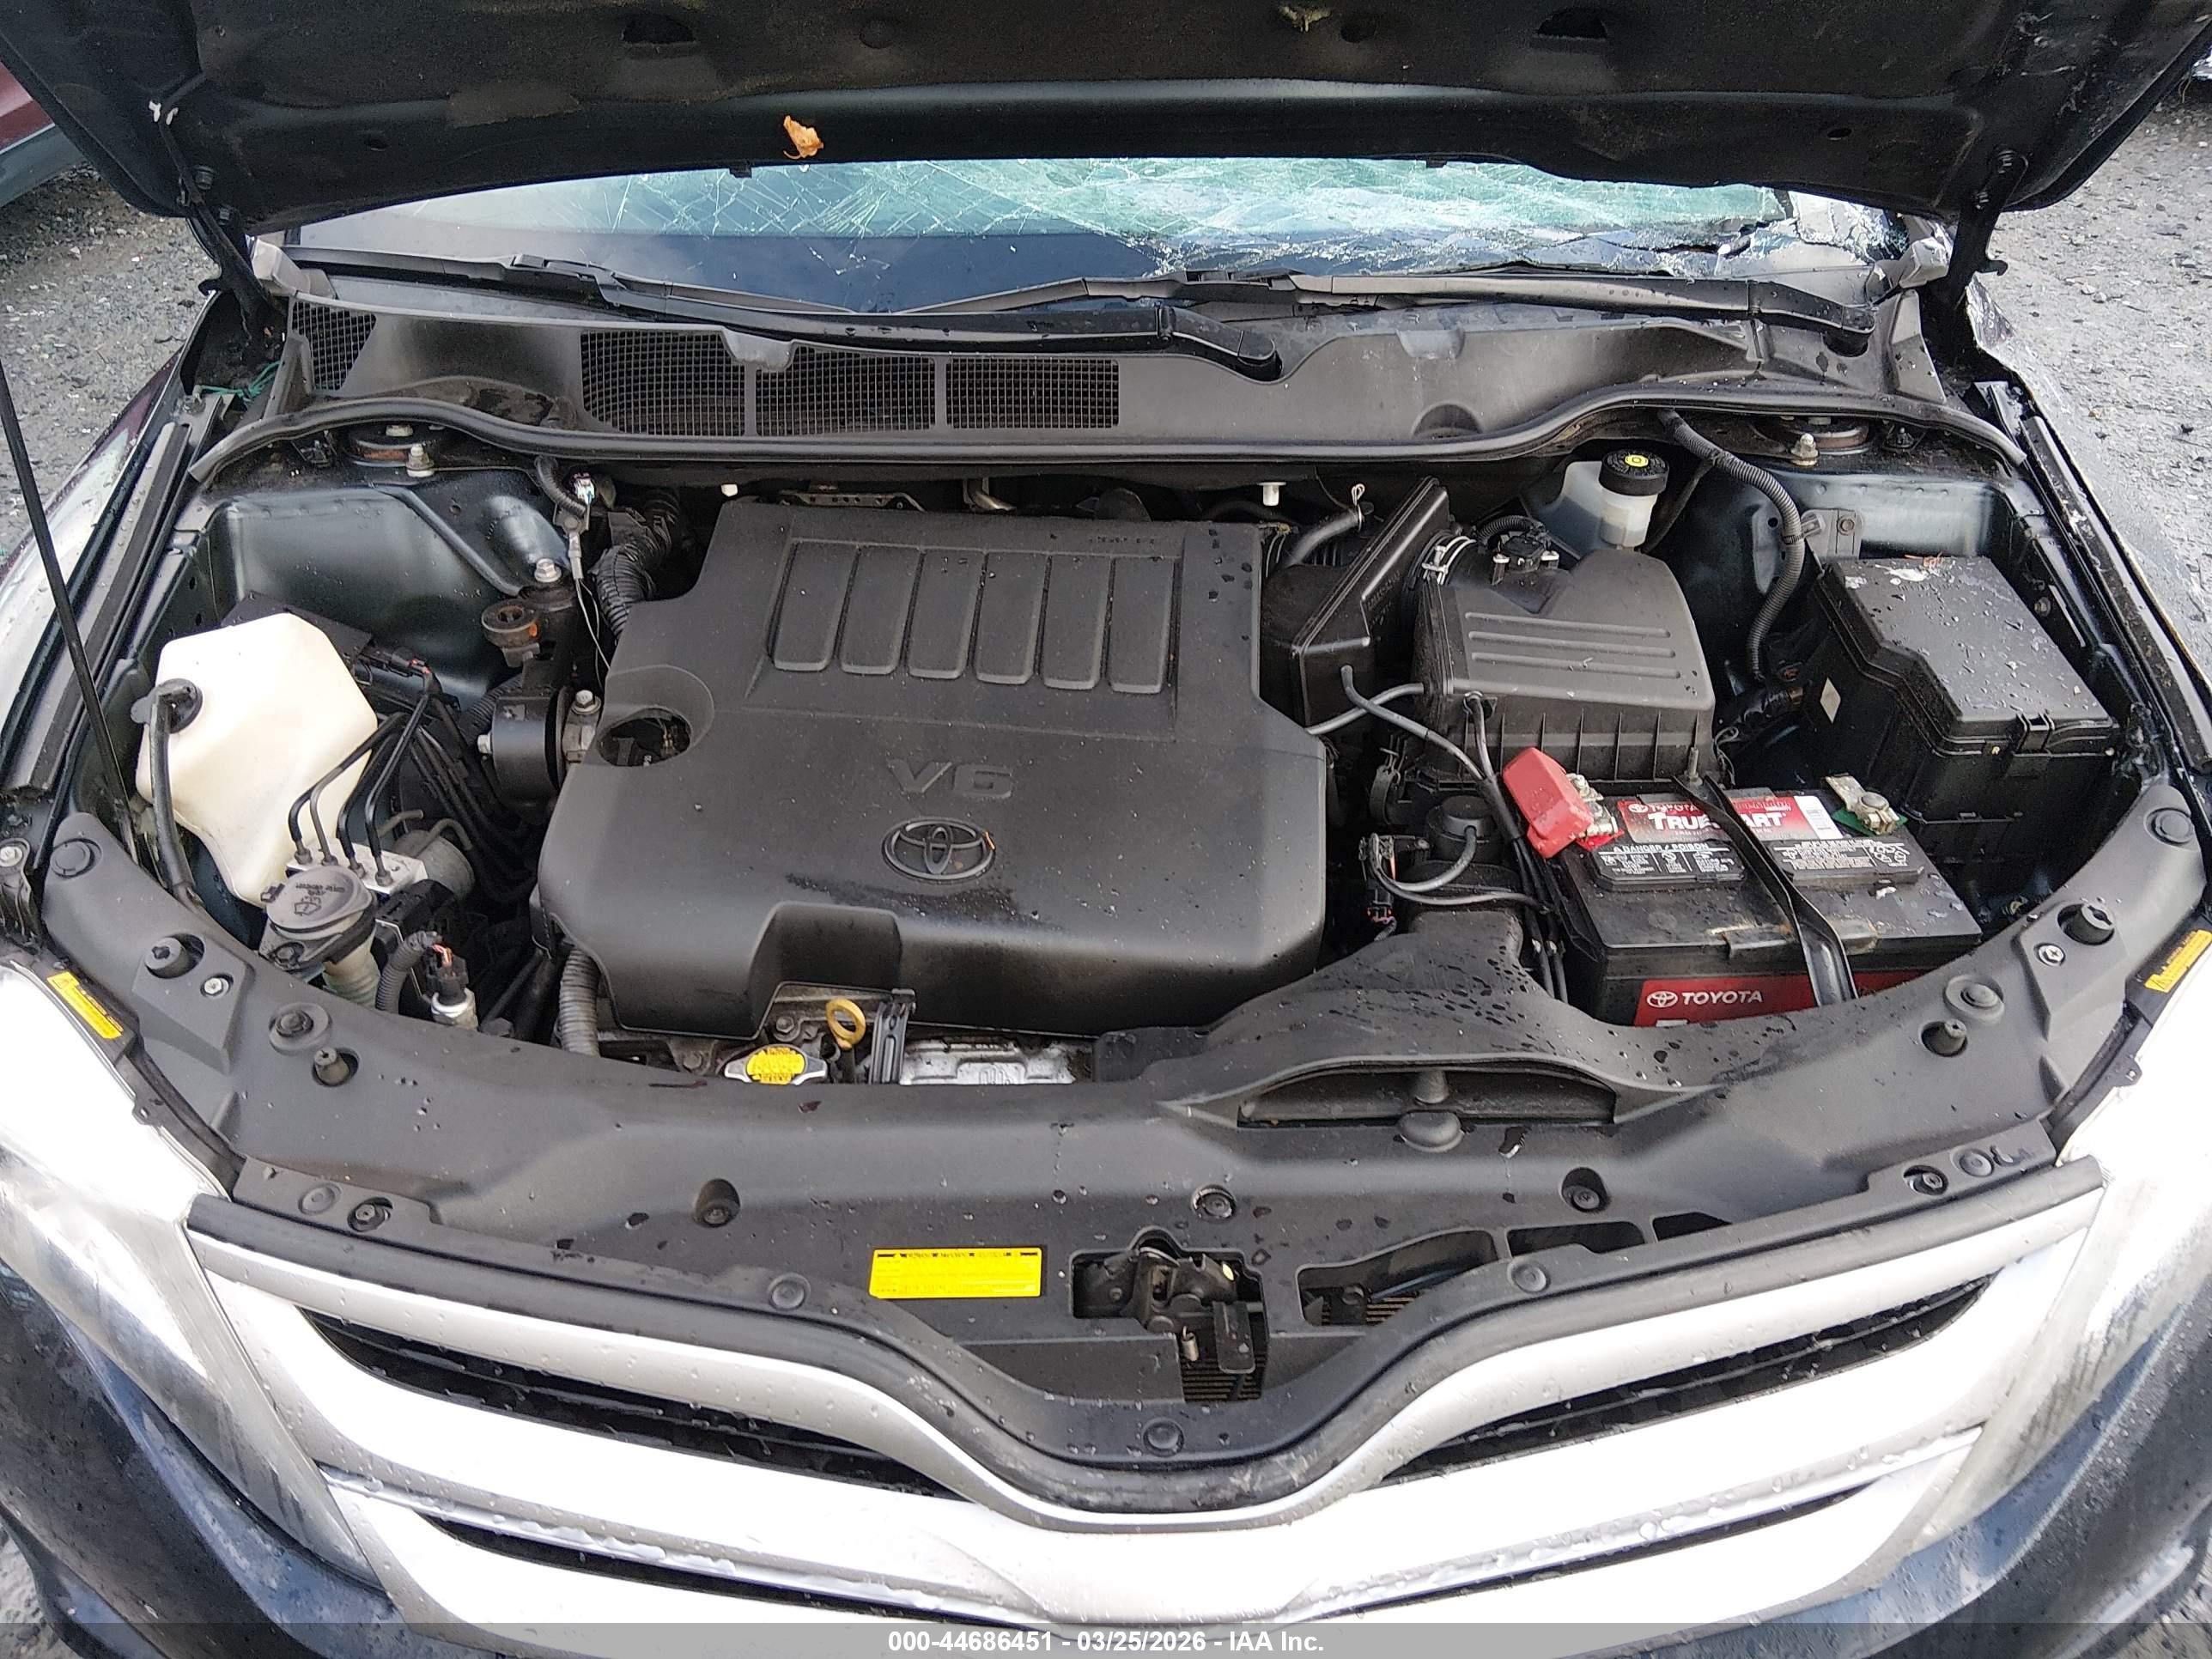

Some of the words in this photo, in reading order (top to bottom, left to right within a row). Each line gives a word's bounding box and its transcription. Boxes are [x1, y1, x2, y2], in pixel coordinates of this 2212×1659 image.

[886, 759, 1014, 799] V6
[1647, 811, 1783, 830] TRUEART
[1682, 990, 1763, 1006] TOYOTA
